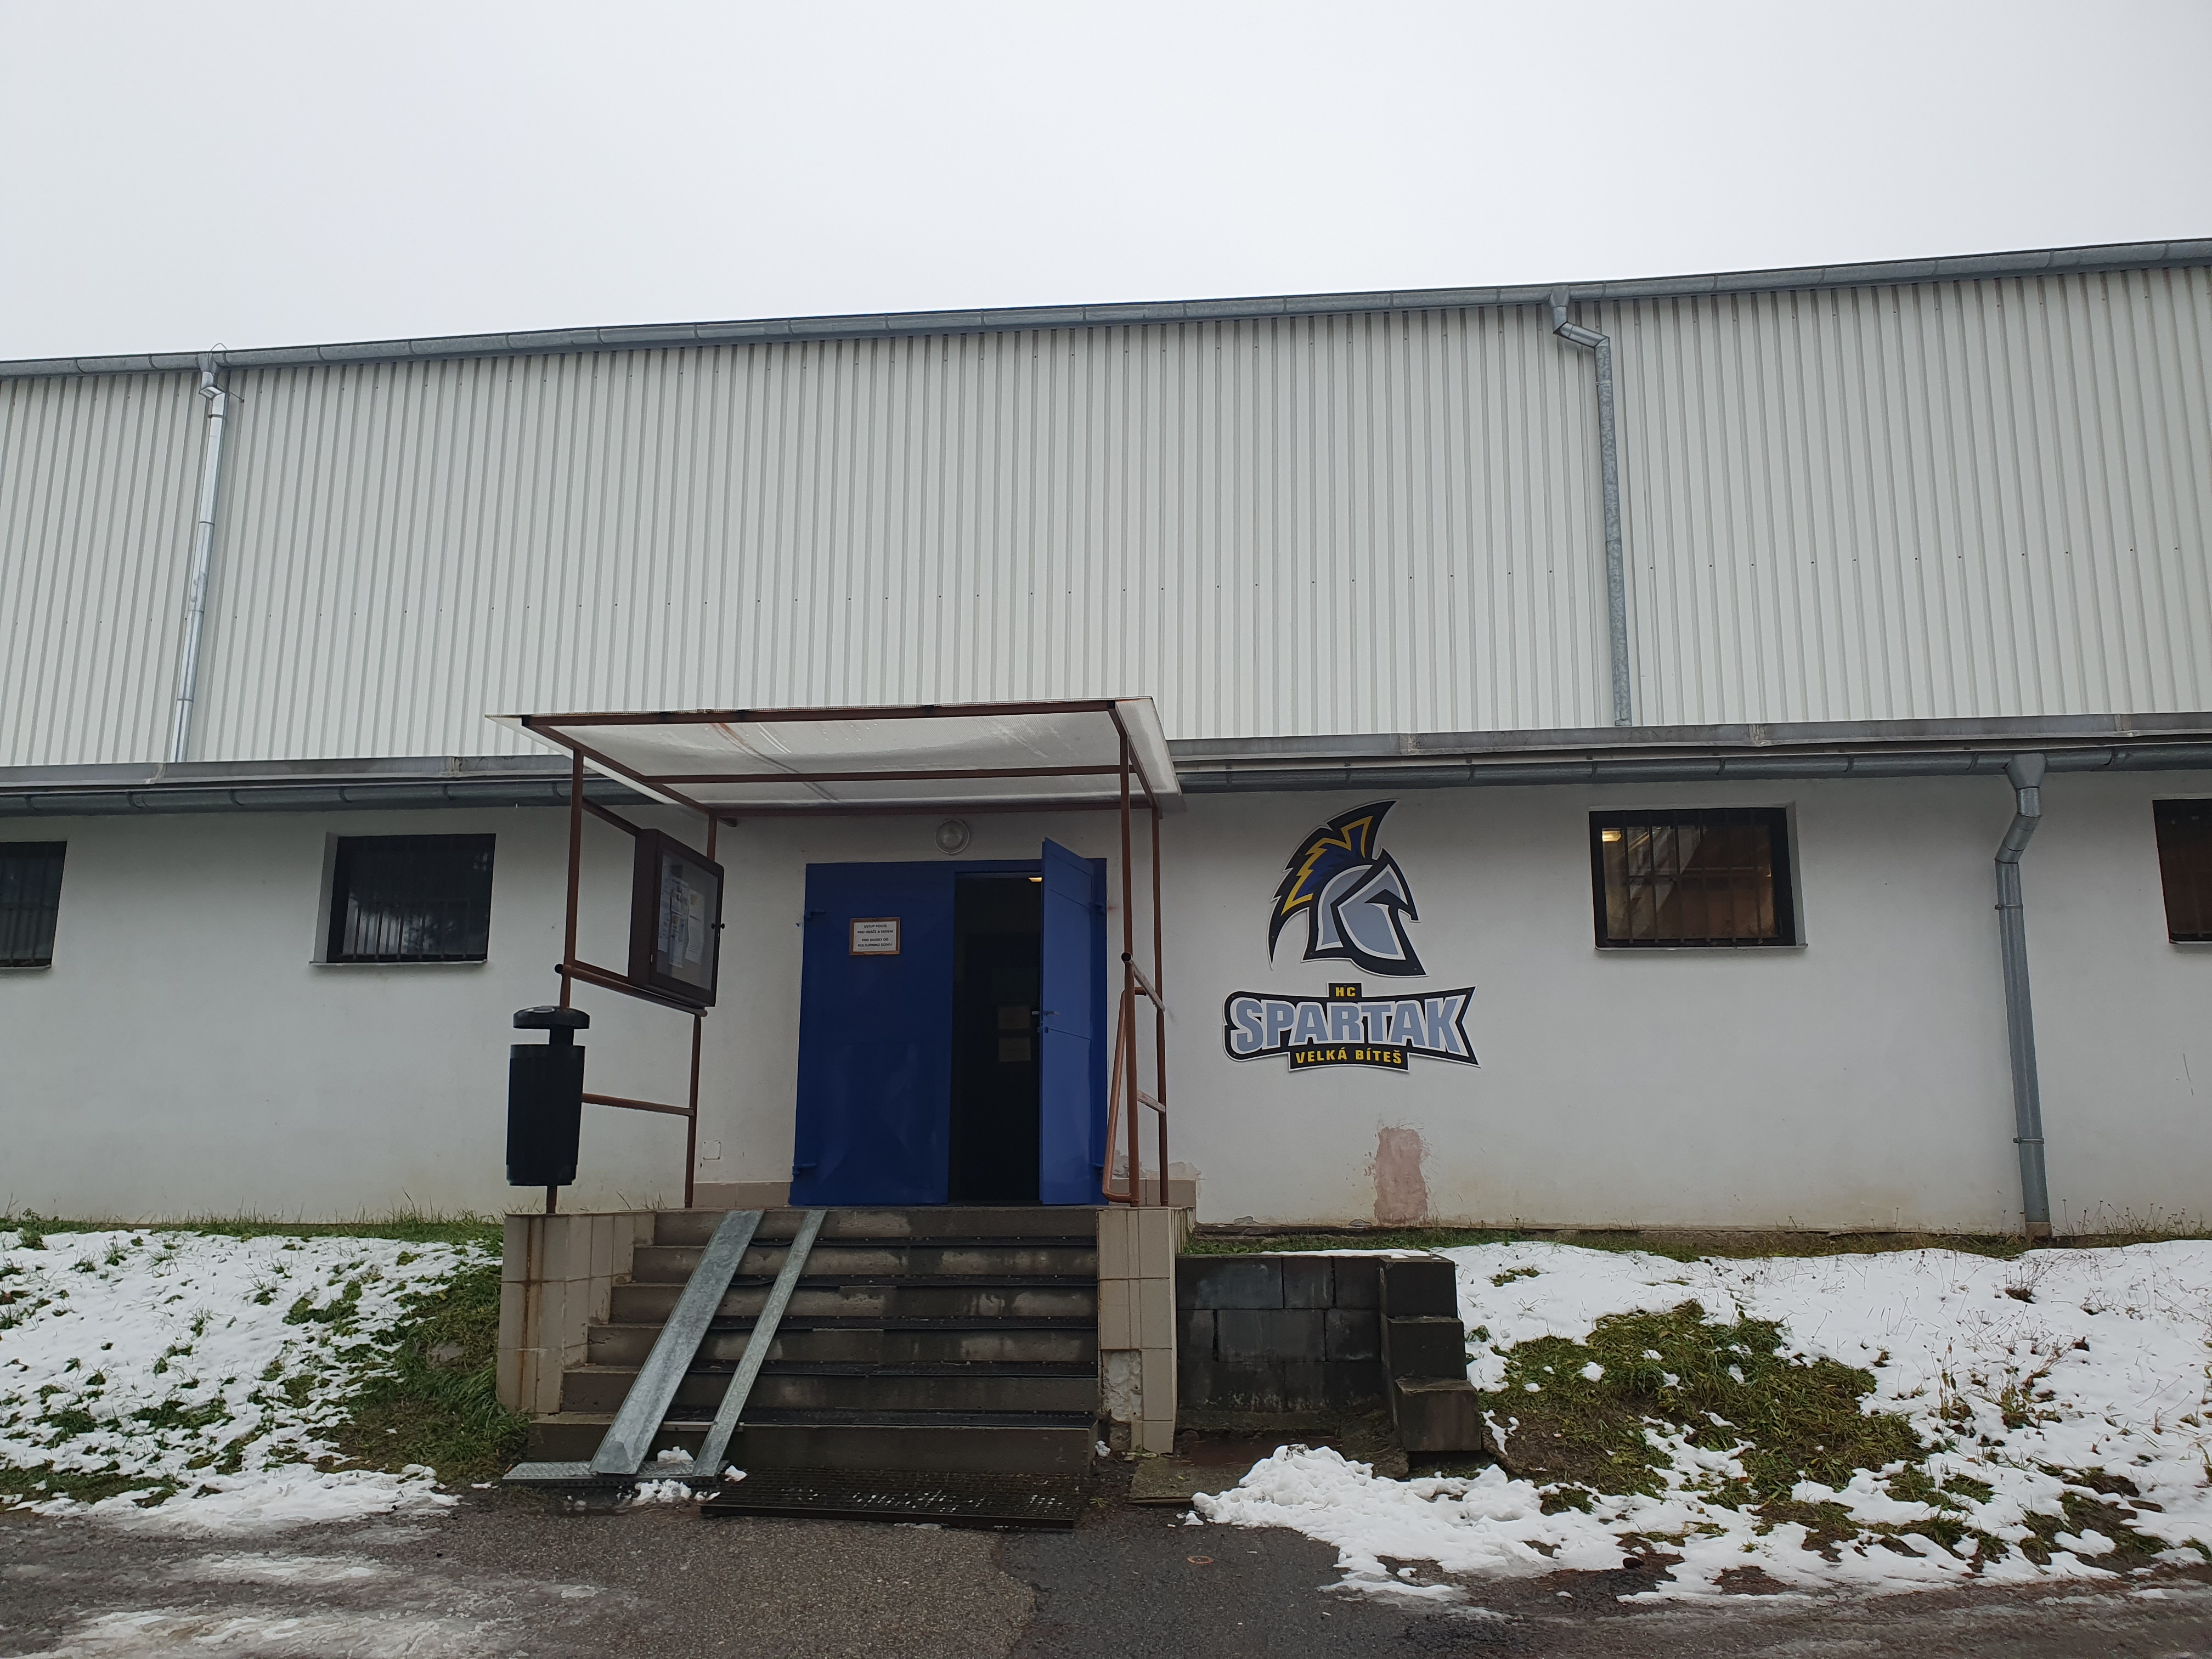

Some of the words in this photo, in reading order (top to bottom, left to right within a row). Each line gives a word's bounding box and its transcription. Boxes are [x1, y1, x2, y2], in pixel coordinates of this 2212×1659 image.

[1335, 986, 1356, 997] HC
[1231, 995, 1469, 1057] SPARTAK
[1295, 1047, 1348, 1064] VELKÁ
[1355, 1047, 1403, 1064] BÍTEŠ
